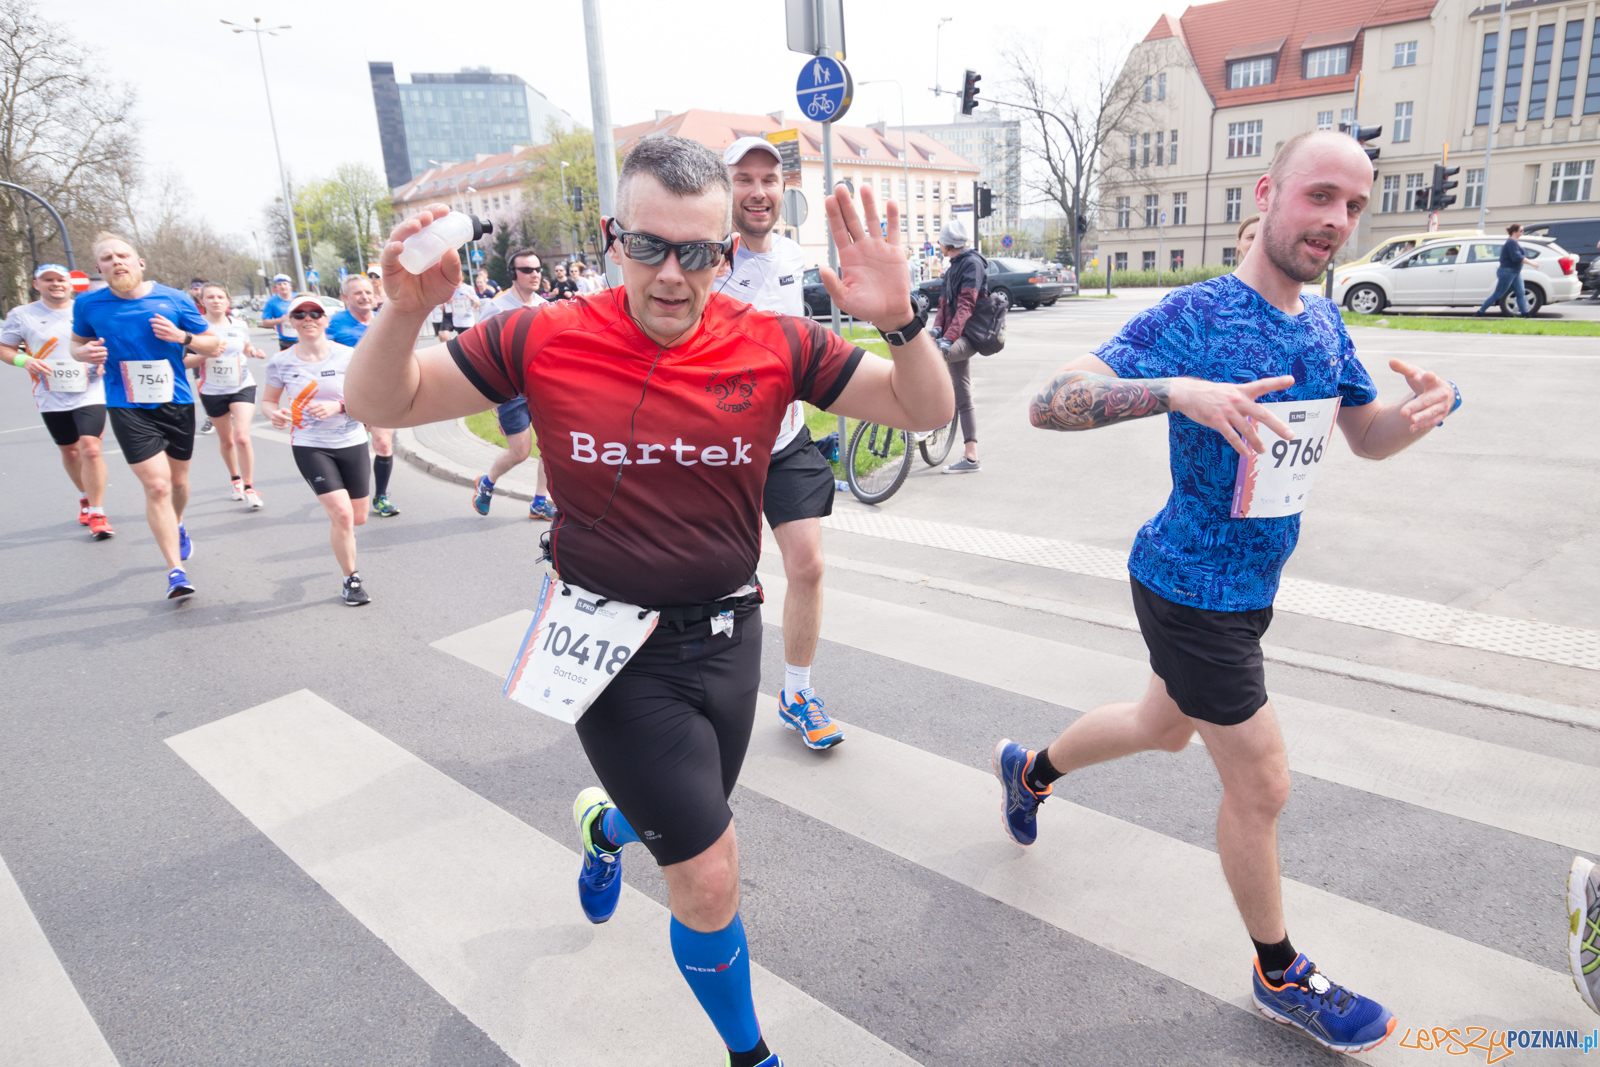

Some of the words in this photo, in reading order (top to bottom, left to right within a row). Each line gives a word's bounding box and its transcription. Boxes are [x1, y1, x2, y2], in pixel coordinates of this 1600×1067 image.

[53, 369, 80, 379] 1989
[137, 373, 169, 385] 7541
[211, 366, 233, 375] 1271
[569, 431, 752, 466] Bartek
[1271, 436, 1325, 469] 9766
[543, 621, 631, 676] 10418
[553, 665, 588, 686] Bartosz
